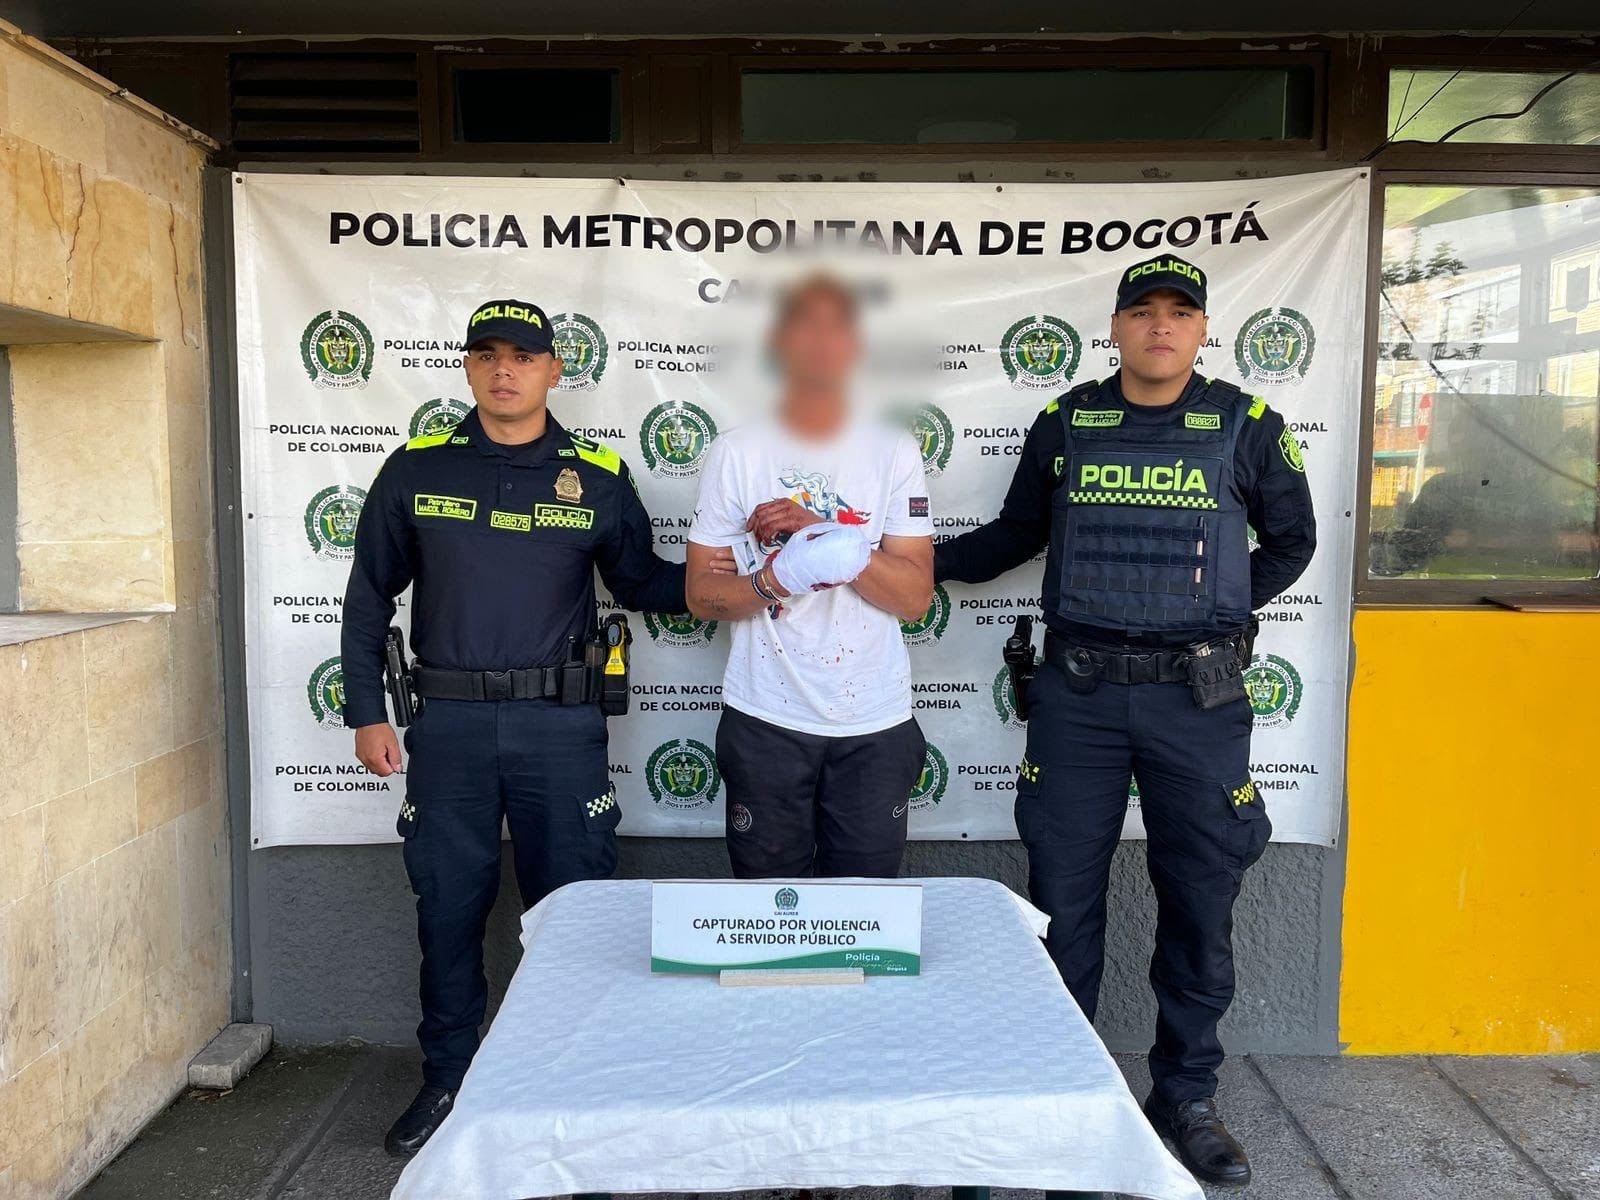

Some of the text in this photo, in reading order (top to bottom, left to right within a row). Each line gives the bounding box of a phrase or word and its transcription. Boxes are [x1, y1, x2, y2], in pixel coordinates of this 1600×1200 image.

[330, 211, 529, 248] POLICIA
[979, 220, 1045, 256] DE
[1060, 200, 1269, 255] BOGOTÁ
[383, 340, 440, 351] POLICIA
[617, 341, 673, 355] POLICIA
[401, 357, 421, 368] DE
[634, 359, 654, 370] DE
[269, 424, 400, 437] POLICIA NACIONAL
[963, 428, 1020, 438] POLICIA
[287, 442, 386, 453] DE COLOMBIA
[981, 446, 999, 456] DE
[1080, 459, 1208, 493] POLICÍA
[493, 514, 529, 528] 028575
[273, 596, 330, 606] POLICIA
[960, 598, 1013, 609] POLICIA
[291, 613, 310, 623] DE
[976, 615, 993, 625] DE
[631, 685, 677, 695] OLICIA
[640, 702, 658, 711] DE
[275, 765, 332, 775] POLICIA
[958, 765, 1011, 775] POLICIA
[294, 782, 390, 792] DE COLOMBIA
[974, 781, 992, 791] DE
[692, 918, 880, 932] CAPTURADO POR VIOLENCIA
[716, 931, 856, 946] A SERVIDOR PÚBLICO
